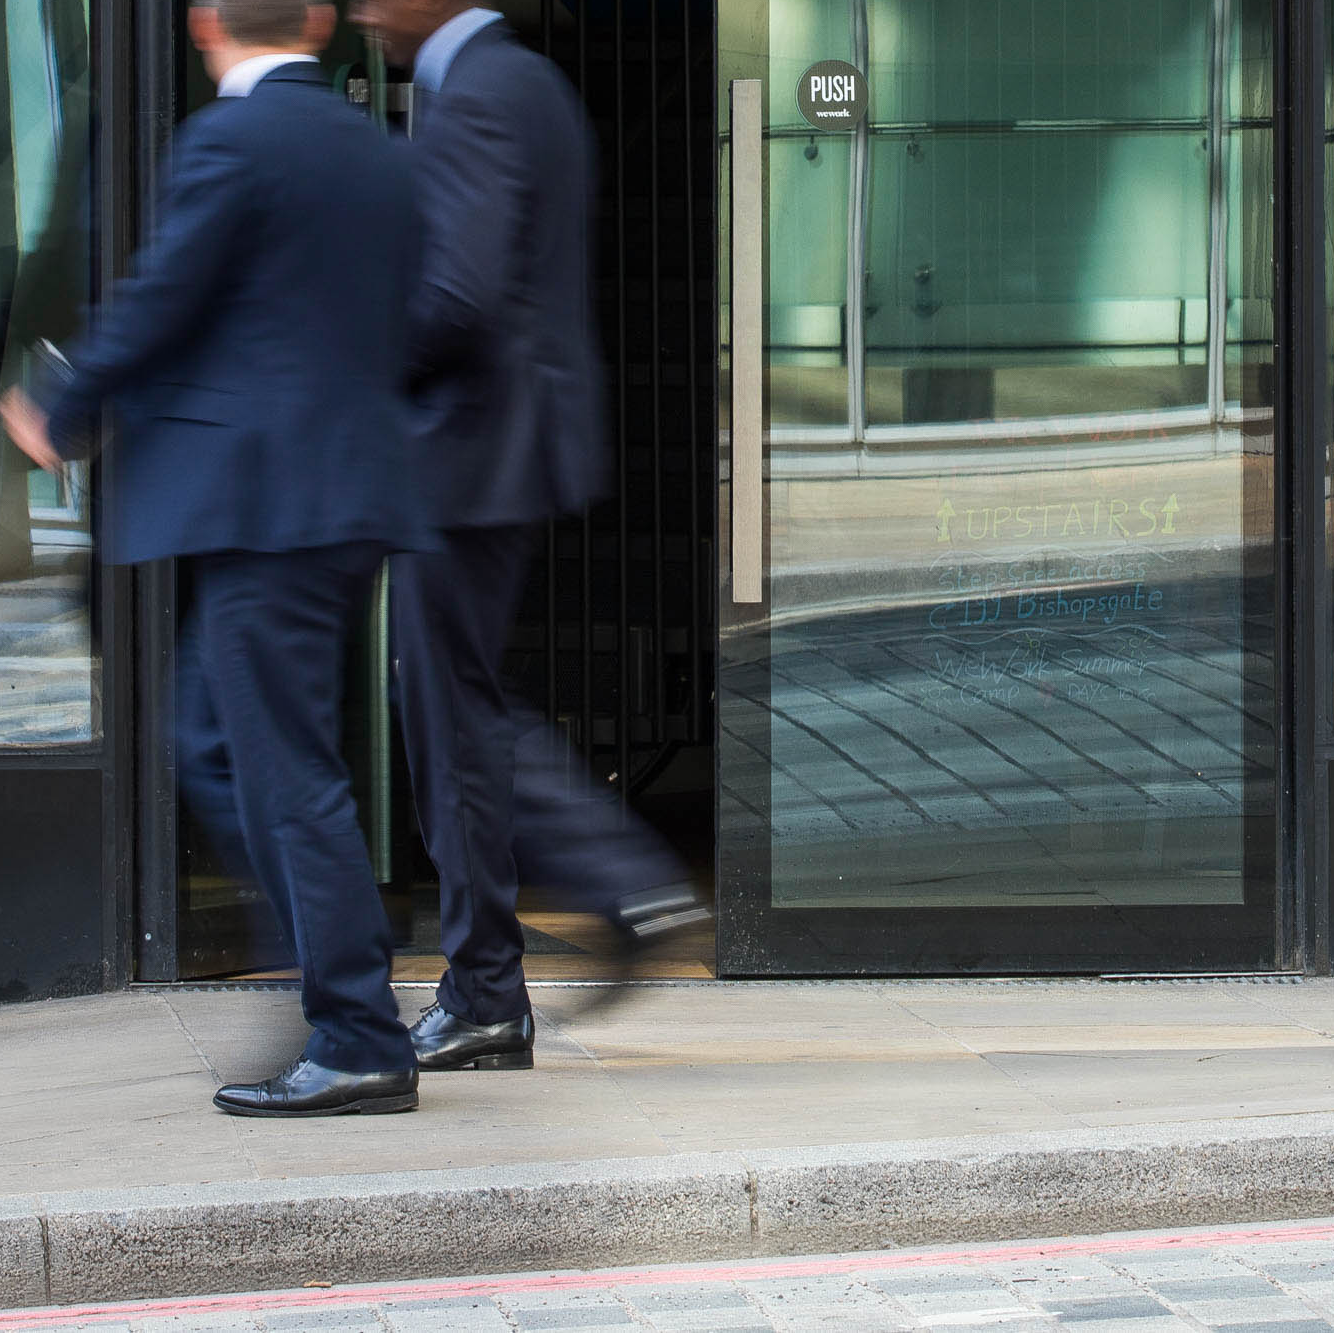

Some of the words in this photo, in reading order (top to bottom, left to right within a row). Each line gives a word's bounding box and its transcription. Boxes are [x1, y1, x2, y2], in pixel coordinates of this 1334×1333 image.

[810, 74, 856, 103] PUSH
[965, 497, 1157, 541] UPSTAIRS
[1017, 582, 1164, 625] Bishopsgate
